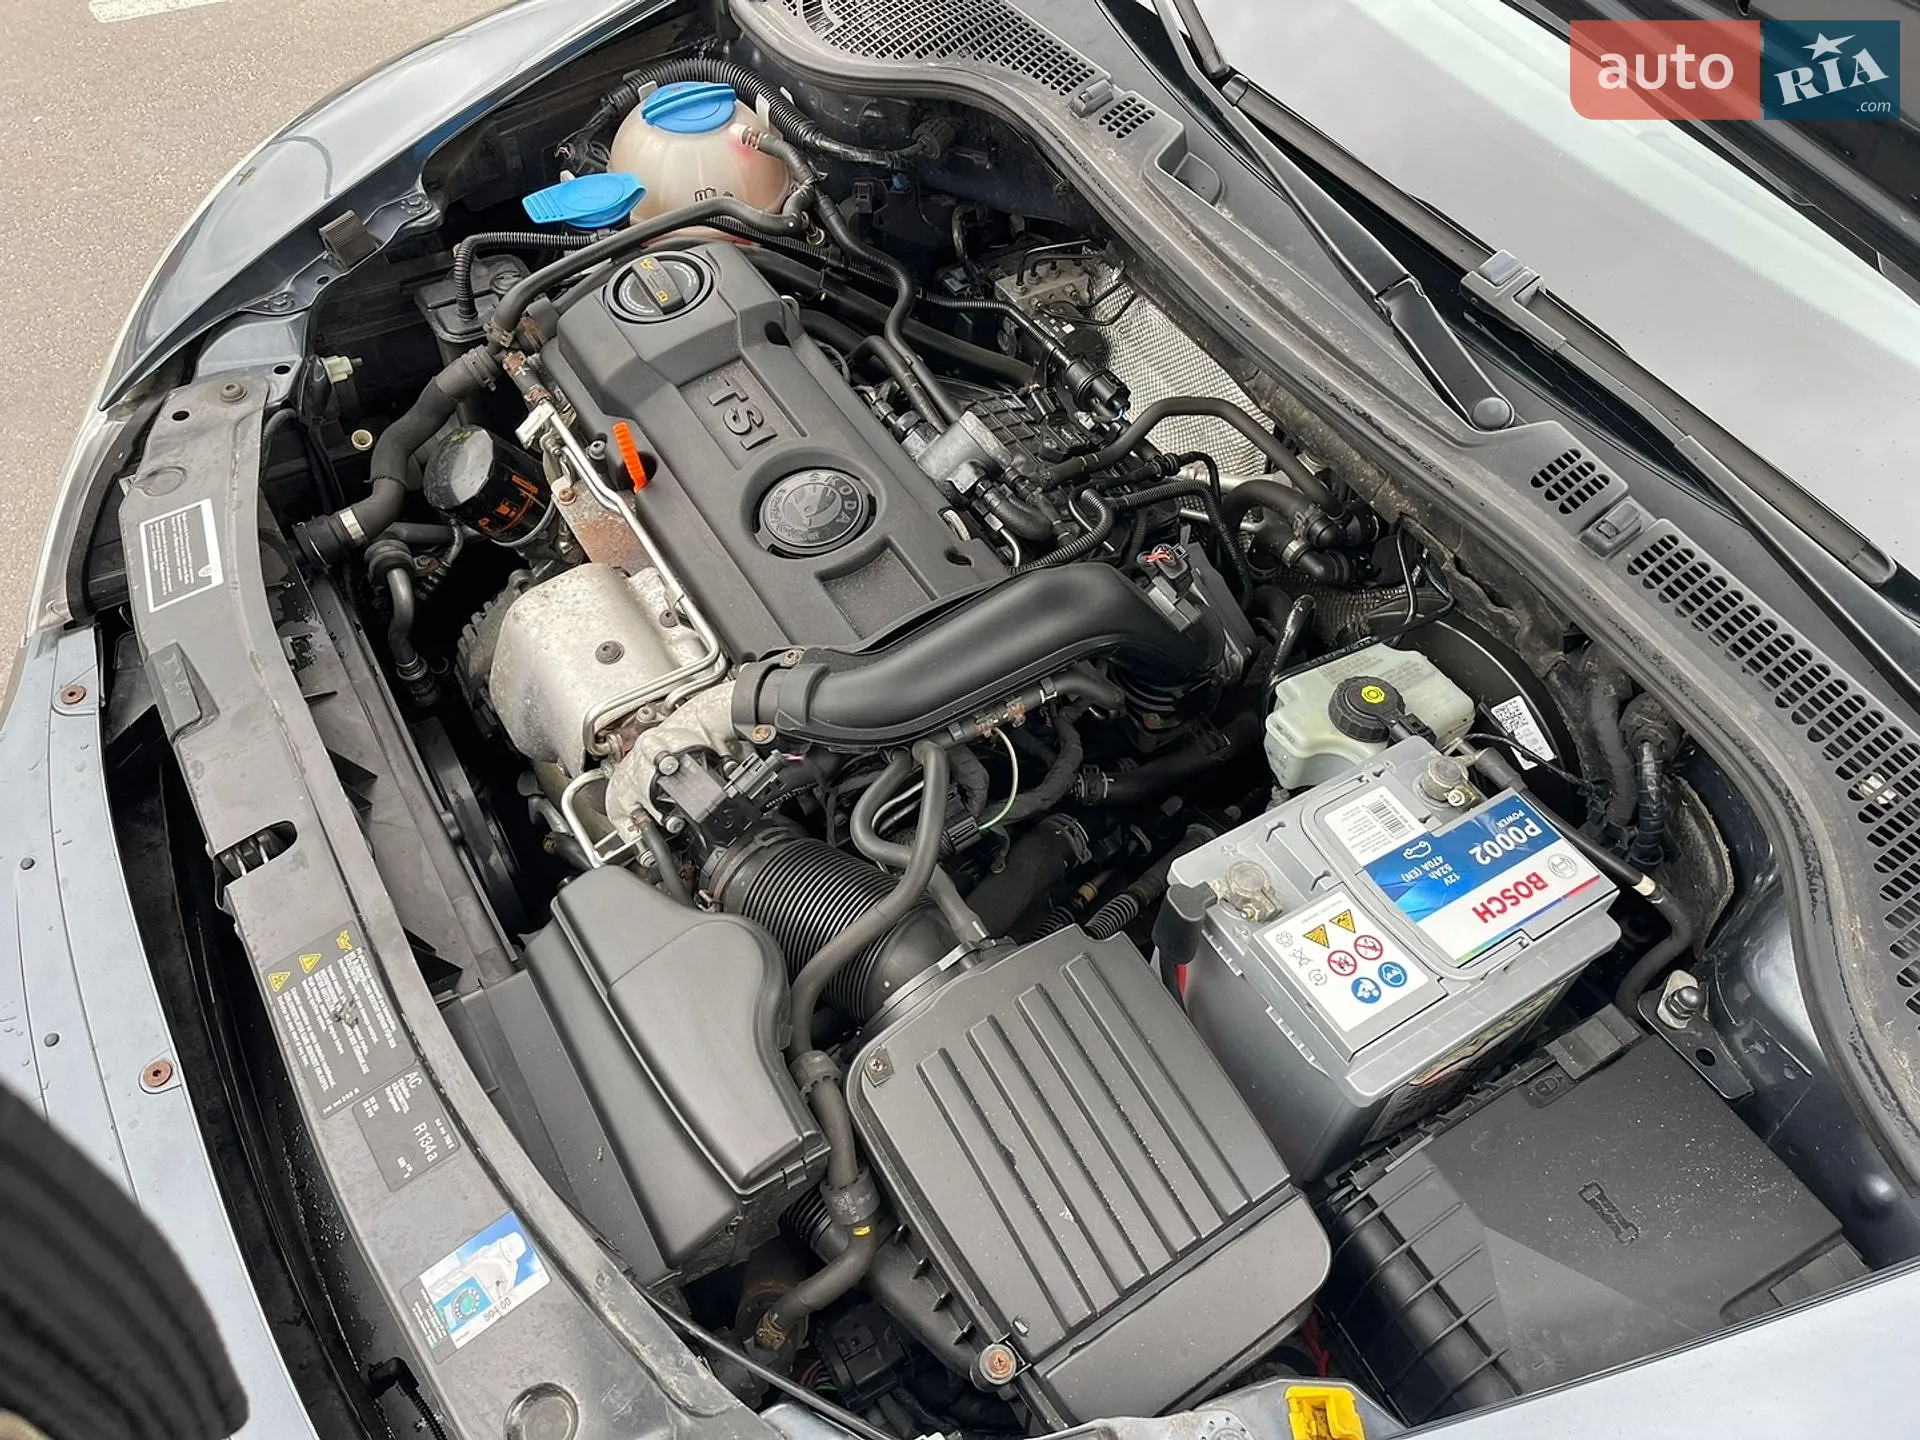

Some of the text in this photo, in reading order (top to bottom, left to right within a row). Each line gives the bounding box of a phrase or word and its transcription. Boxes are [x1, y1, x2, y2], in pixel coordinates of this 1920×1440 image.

[706, 378, 778, 451] TSI
[1495, 809, 1525, 828] POWER
[1468, 817, 1543, 866] P0002
[1401, 854, 1444, 884] 470A (EN)
[1427, 863, 1454, 881] 52Ah
[1443, 871, 1461, 887] 12V
[1471, 872, 1549, 924] BOSCH
[404, 1071, 423, 1089] AC
[413, 1121, 438, 1162] R134a
